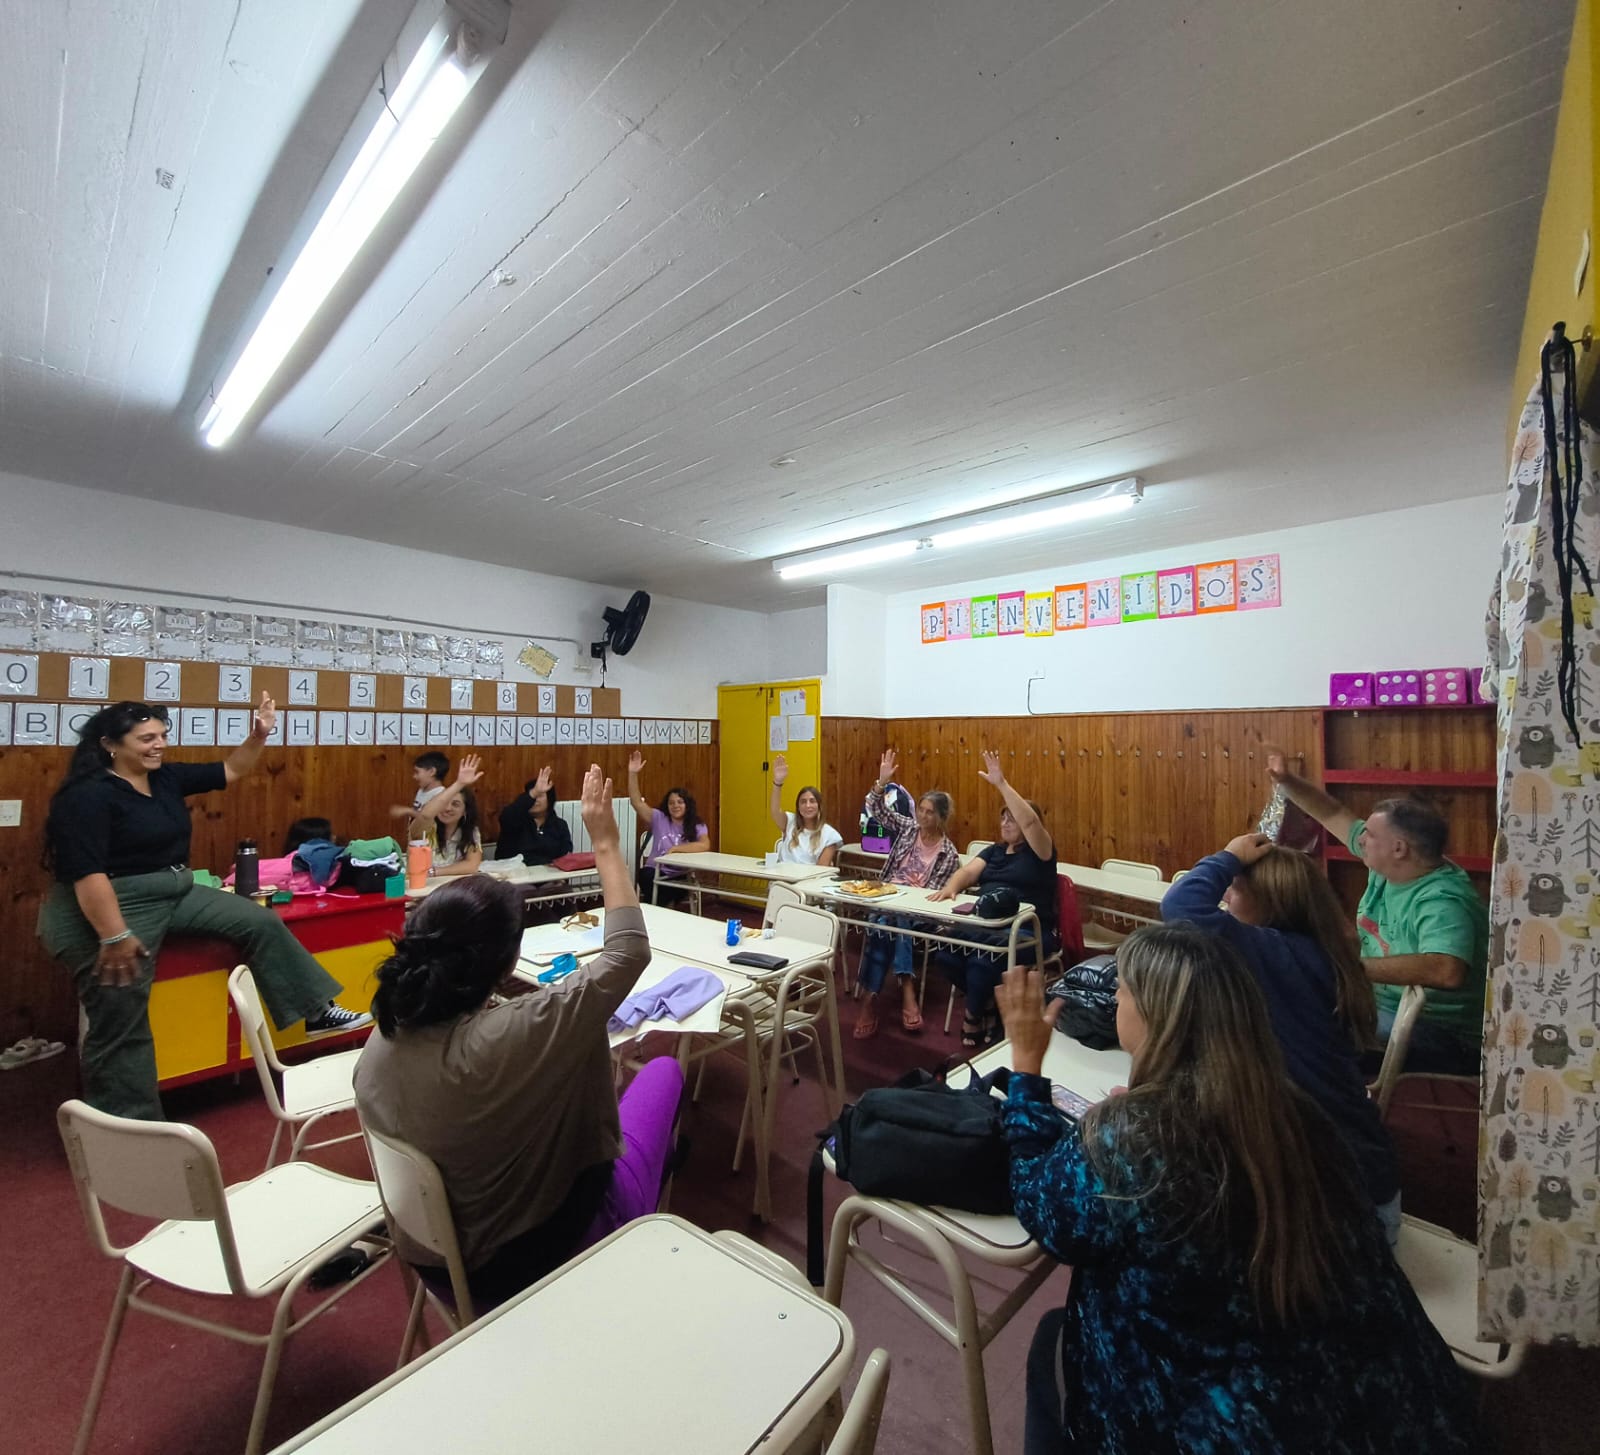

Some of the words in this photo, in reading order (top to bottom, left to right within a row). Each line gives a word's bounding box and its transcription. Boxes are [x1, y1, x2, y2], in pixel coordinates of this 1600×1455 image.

[84, 667, 93, 686] 1
[155, 670, 170, 690] 2
[228, 674, 242, 692] 3
[296, 678, 310, 695] 4
[357, 682, 368, 698] 5
[410, 684, 421, 700] 6
[458, 686, 467, 701] 7
[502, 689, 511, 703] 8
[542, 691, 551, 705] 9
[26, 712, 48, 733] B
[192, 716, 206, 735] E
[228, 718, 242, 735] F
[294, 719, 309, 736] H
[355, 720, 366, 736] J
[382, 720, 396, 736] K
[410, 721, 419, 736] L
[455, 722, 469, 736] M
[478, 722, 491, 736] N
[500, 720, 512, 737] Ñ
[521, 723, 534, 737] O
[542, 723, 552, 736] P
[560, 723, 571, 738] Q
[578, 724, 588, 737] R
[596, 724, 605, 737] S
[613, 724, 621, 737] T
[628, 725, 637, 737] U
[644, 726, 653, 737] V
[657, 726, 671, 737] W
[673, 726, 681, 737] X
[686, 726, 695, 737] Y
[701, 726, 709, 738] Z
